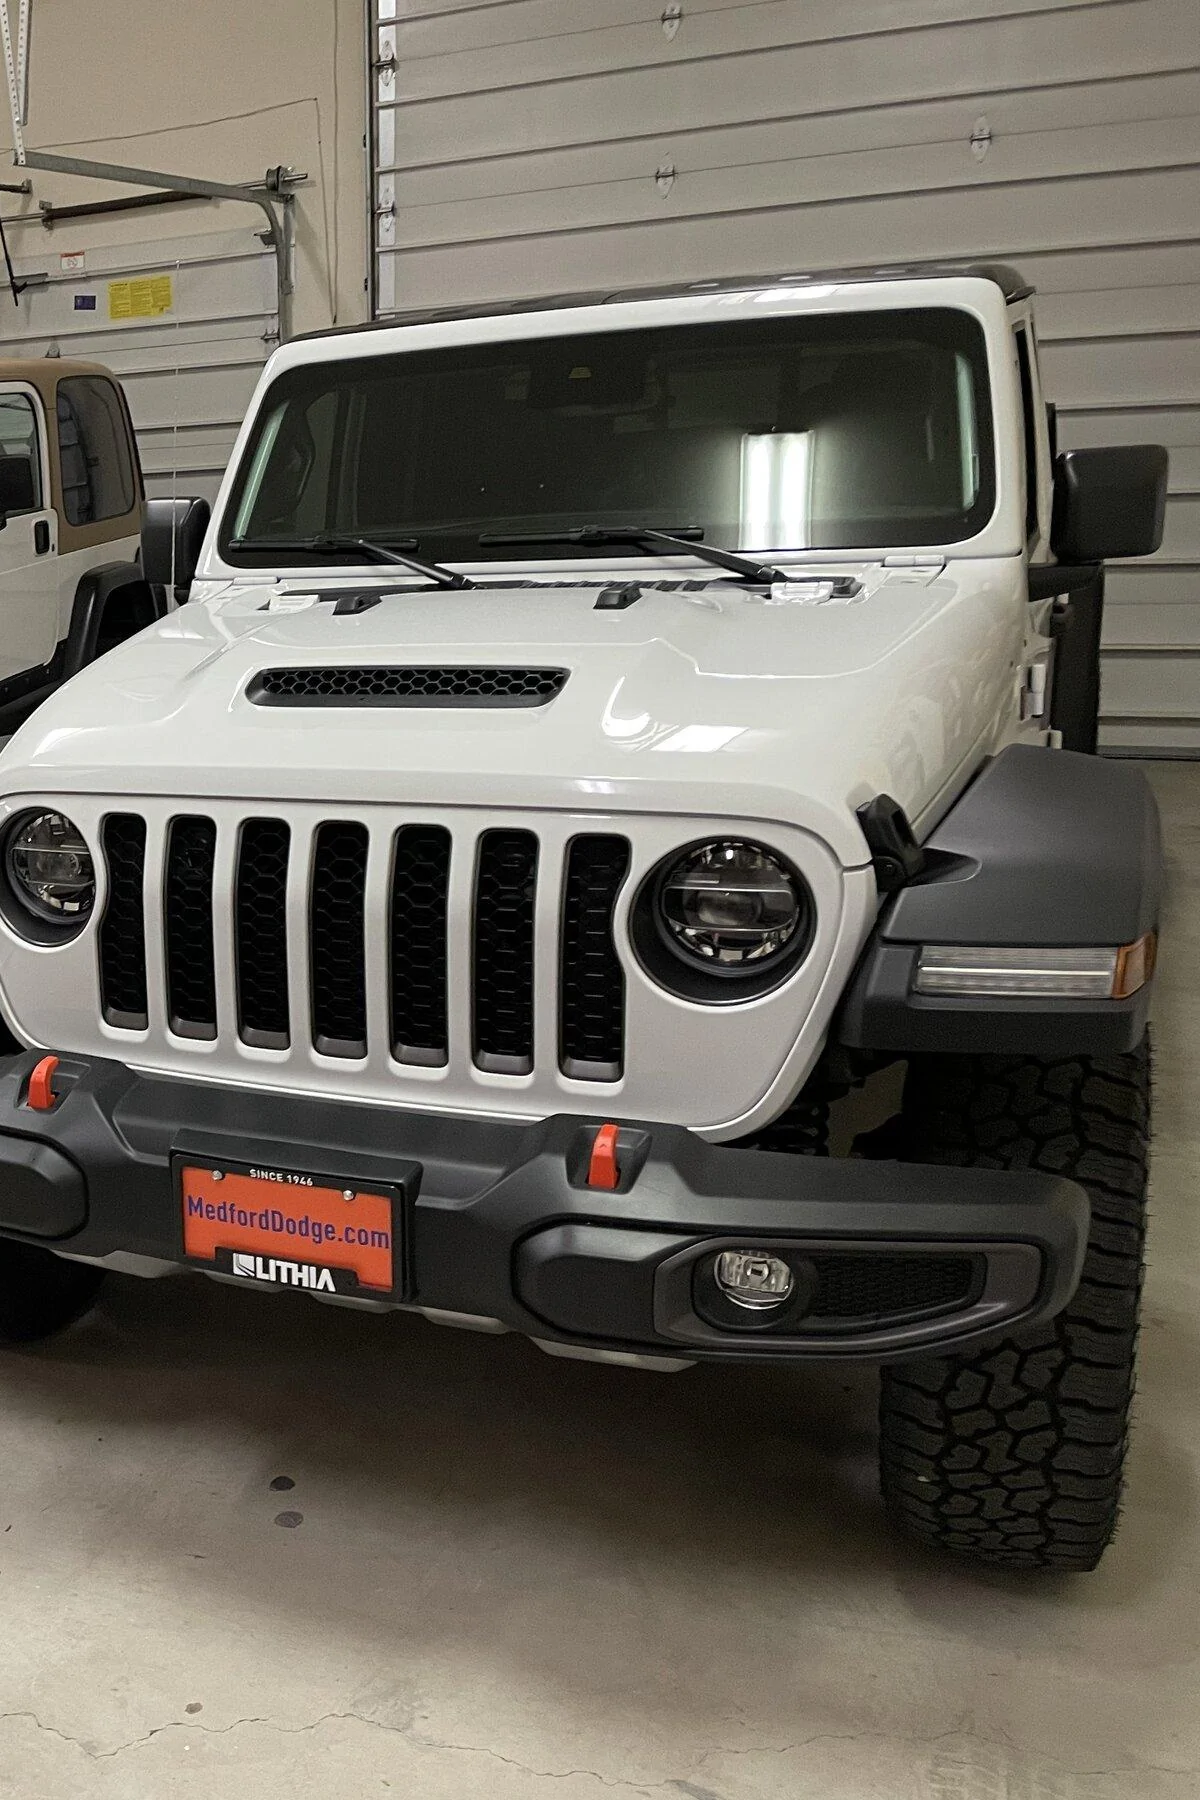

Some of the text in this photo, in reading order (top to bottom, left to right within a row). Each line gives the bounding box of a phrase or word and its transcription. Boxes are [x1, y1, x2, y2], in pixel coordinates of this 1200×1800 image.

[249, 1168, 313, 1187] SINCE 1946
[187, 1195, 390, 1249] MedfordDodge.com
[256, 1257, 336, 1292] LITHIA
